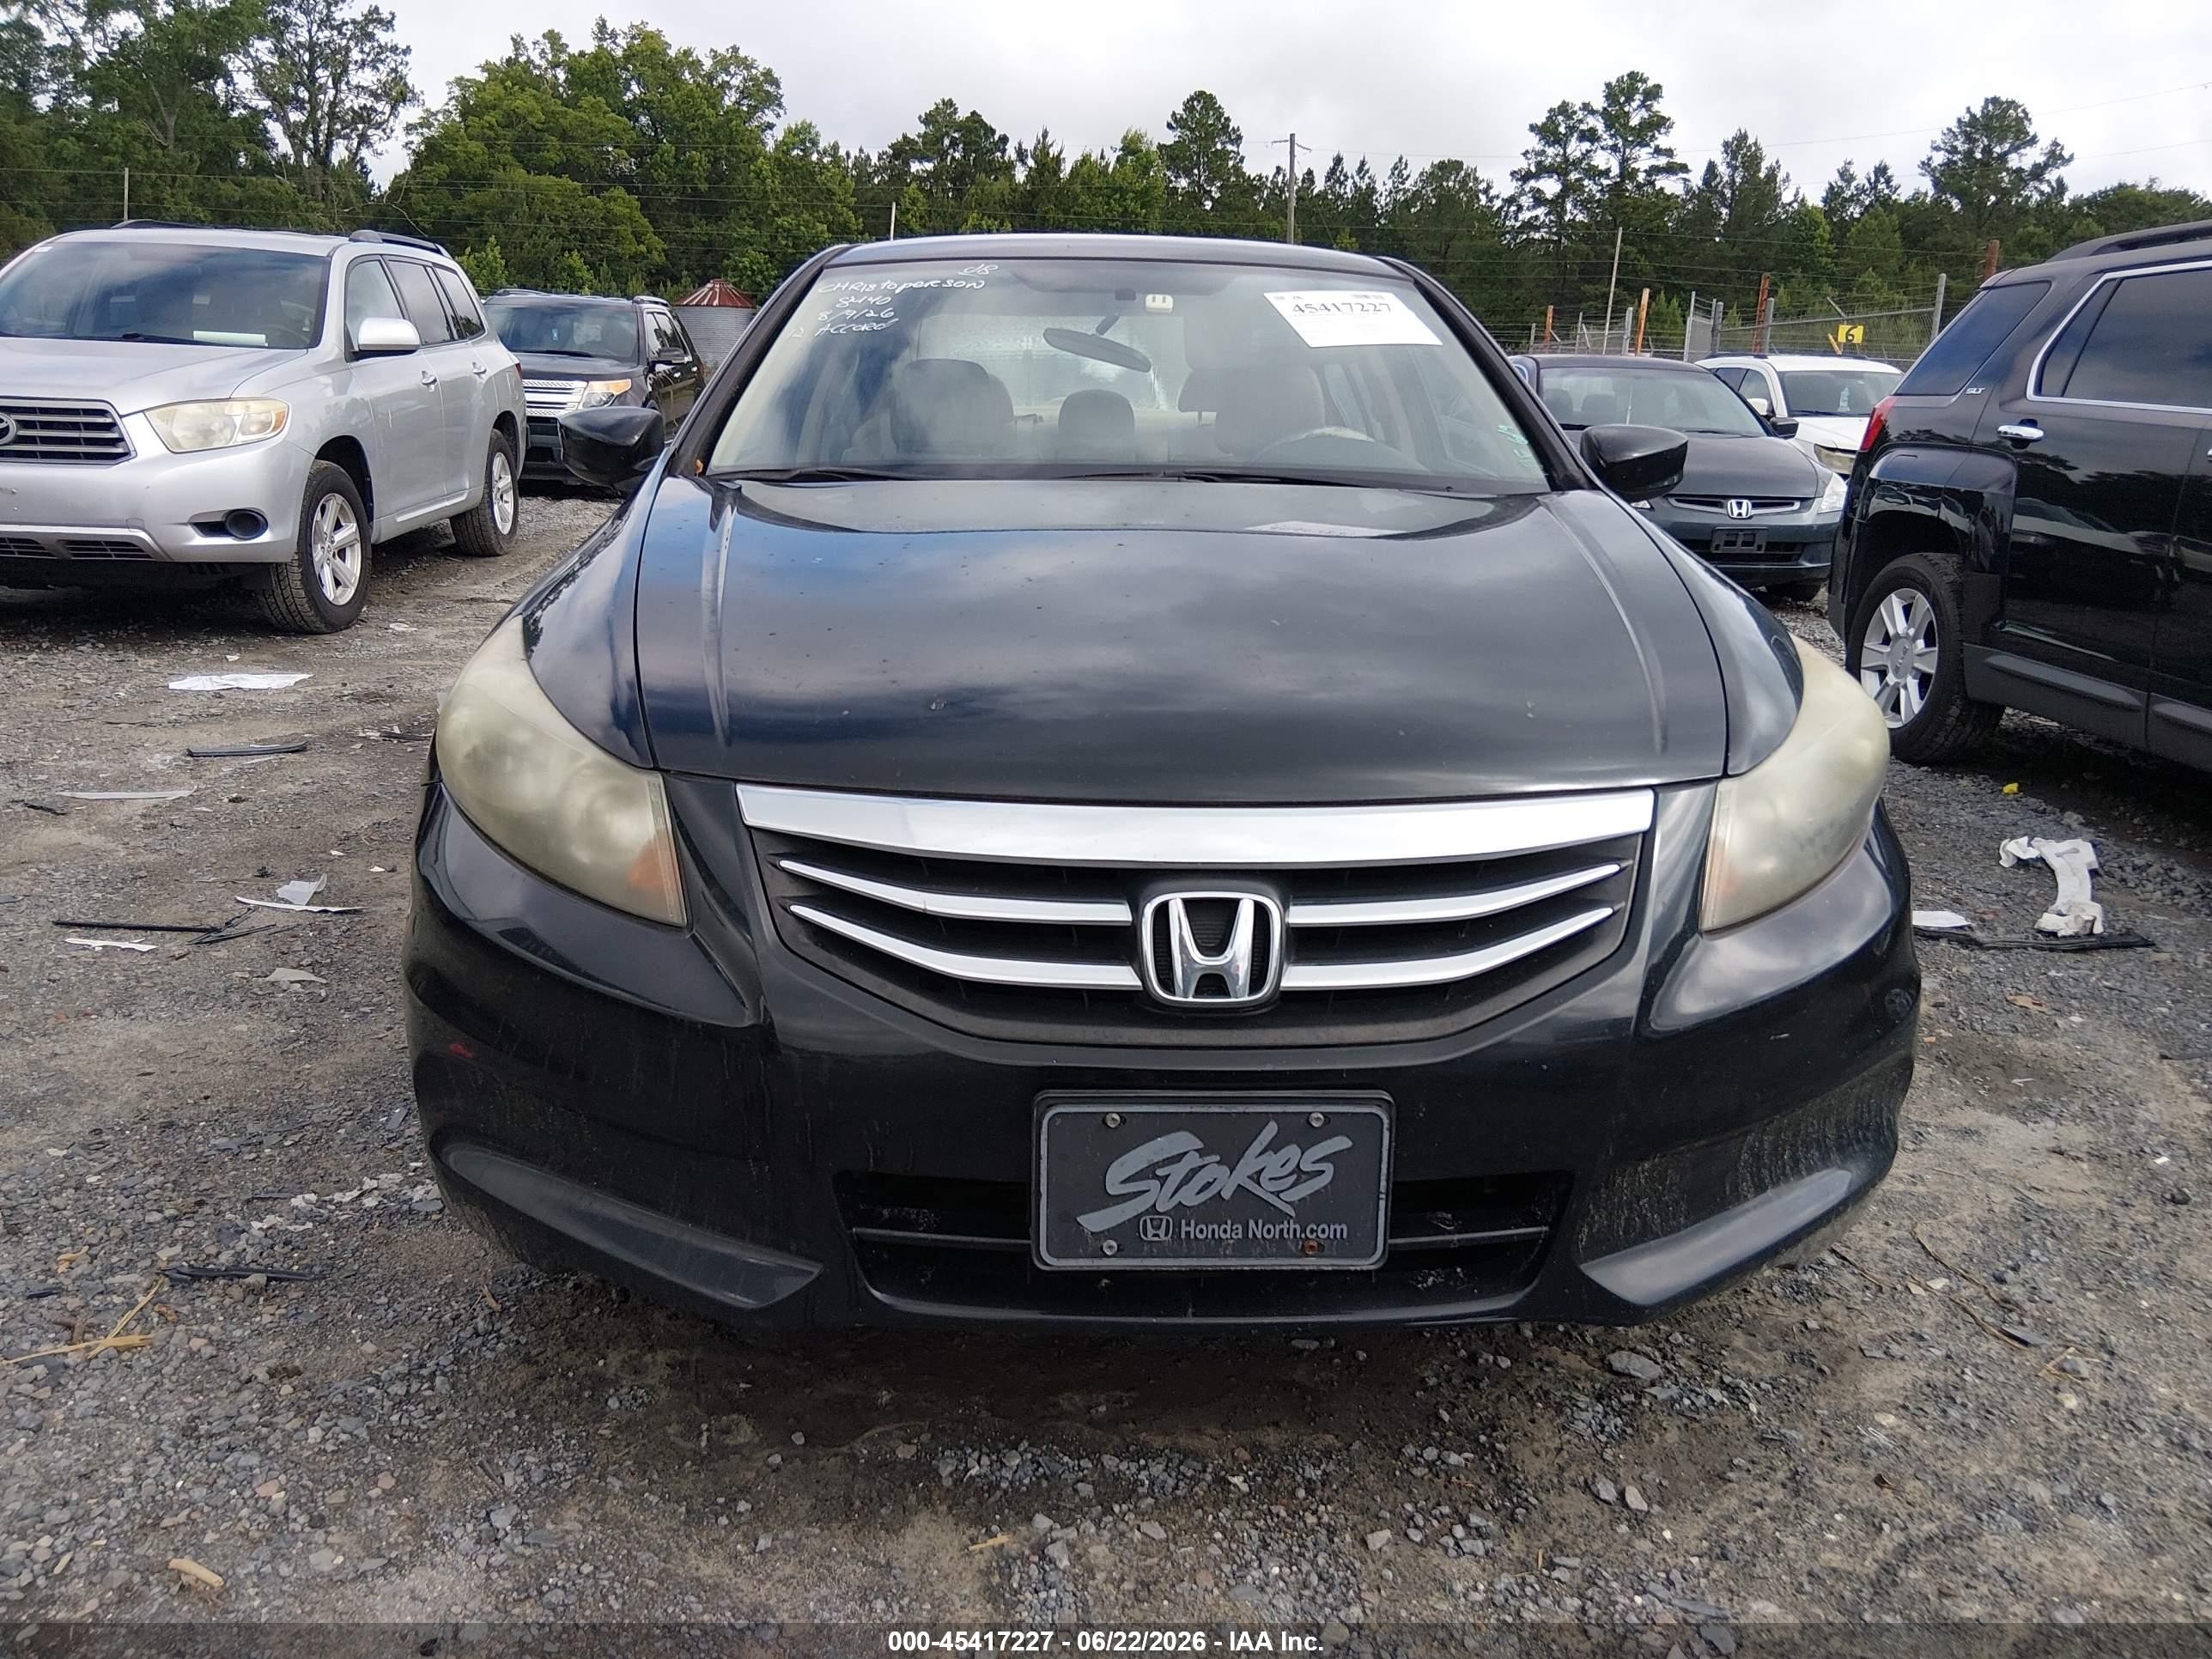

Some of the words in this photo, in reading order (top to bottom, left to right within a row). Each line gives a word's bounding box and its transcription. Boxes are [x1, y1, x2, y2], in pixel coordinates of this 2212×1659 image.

[1292, 302, 1391, 313] 45417227
[1845, 326, 1857, 341] 6
[1076, 1120, 1353, 1233] Stokes
[1181, 1219, 1242, 1239] Honda
[1248, 1219, 1347, 1239] North.com
